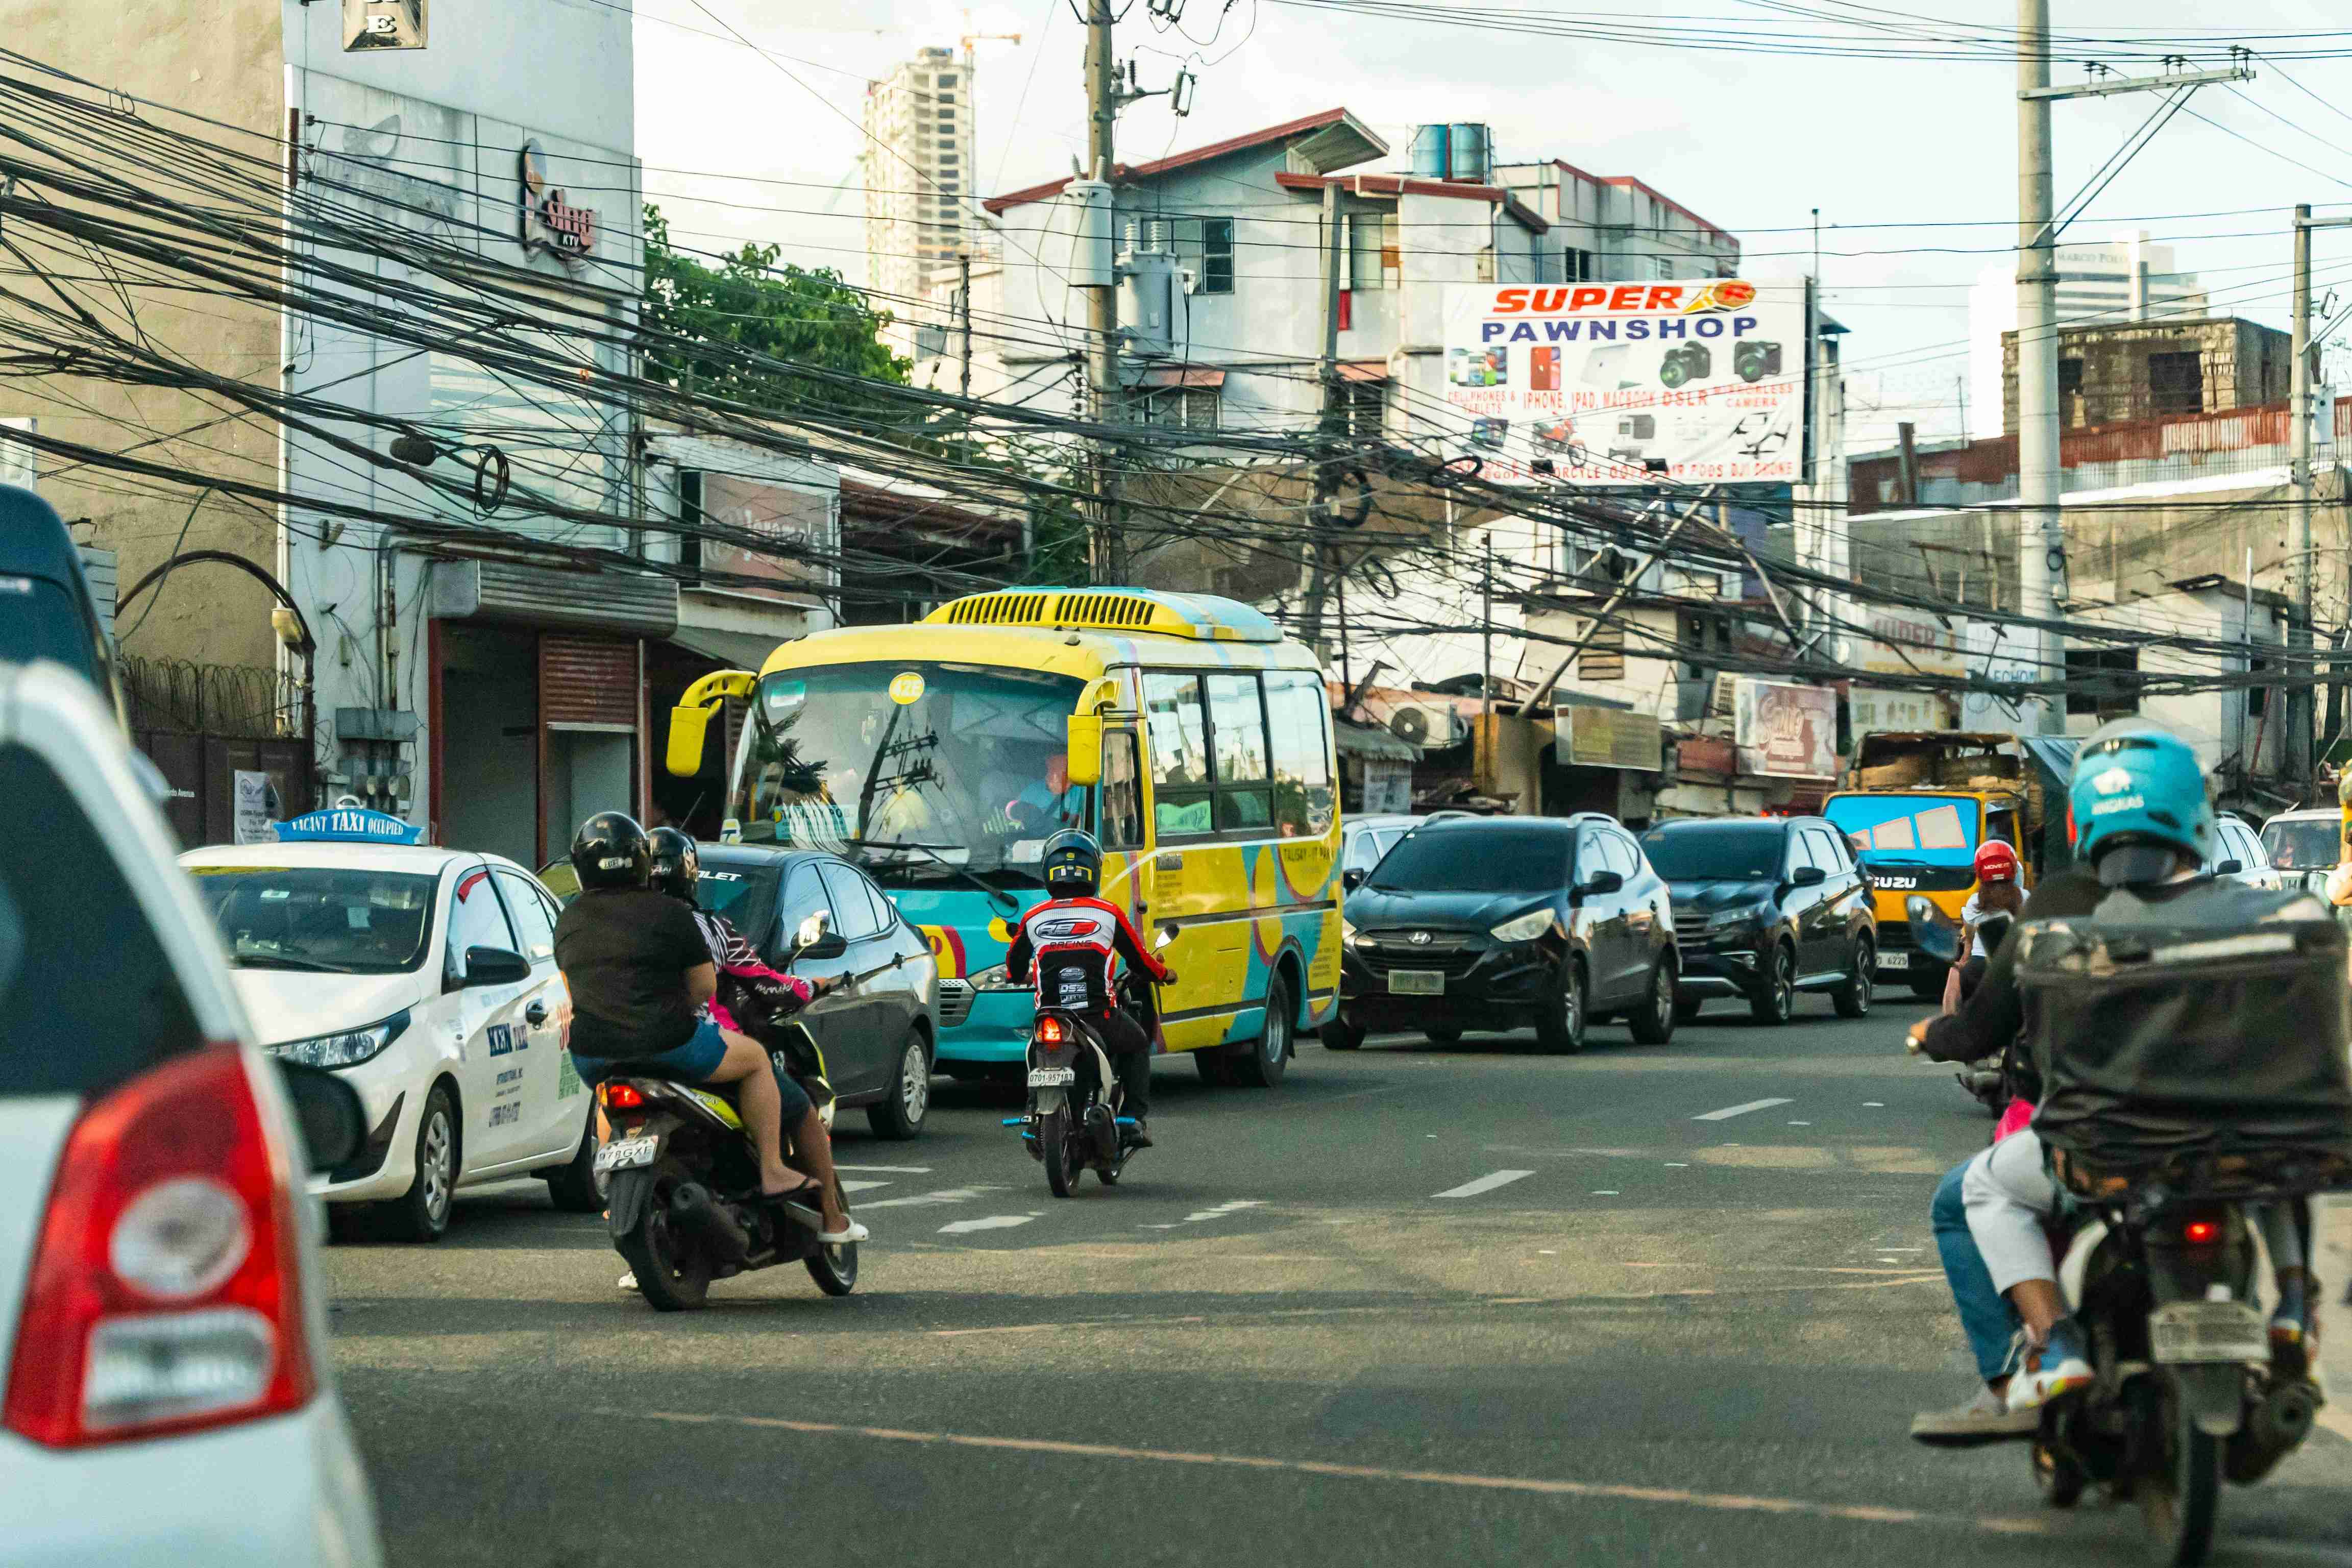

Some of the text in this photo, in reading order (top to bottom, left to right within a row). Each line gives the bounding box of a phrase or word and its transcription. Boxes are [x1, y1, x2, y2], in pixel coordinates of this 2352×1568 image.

[562, 235, 579, 247] KTV
[1493, 286, 1683, 313] SUPER
[1482, 317, 1757, 342] PAWNSHOP
[291, 812, 404, 836] VACANT TAXI OCCUPIED
